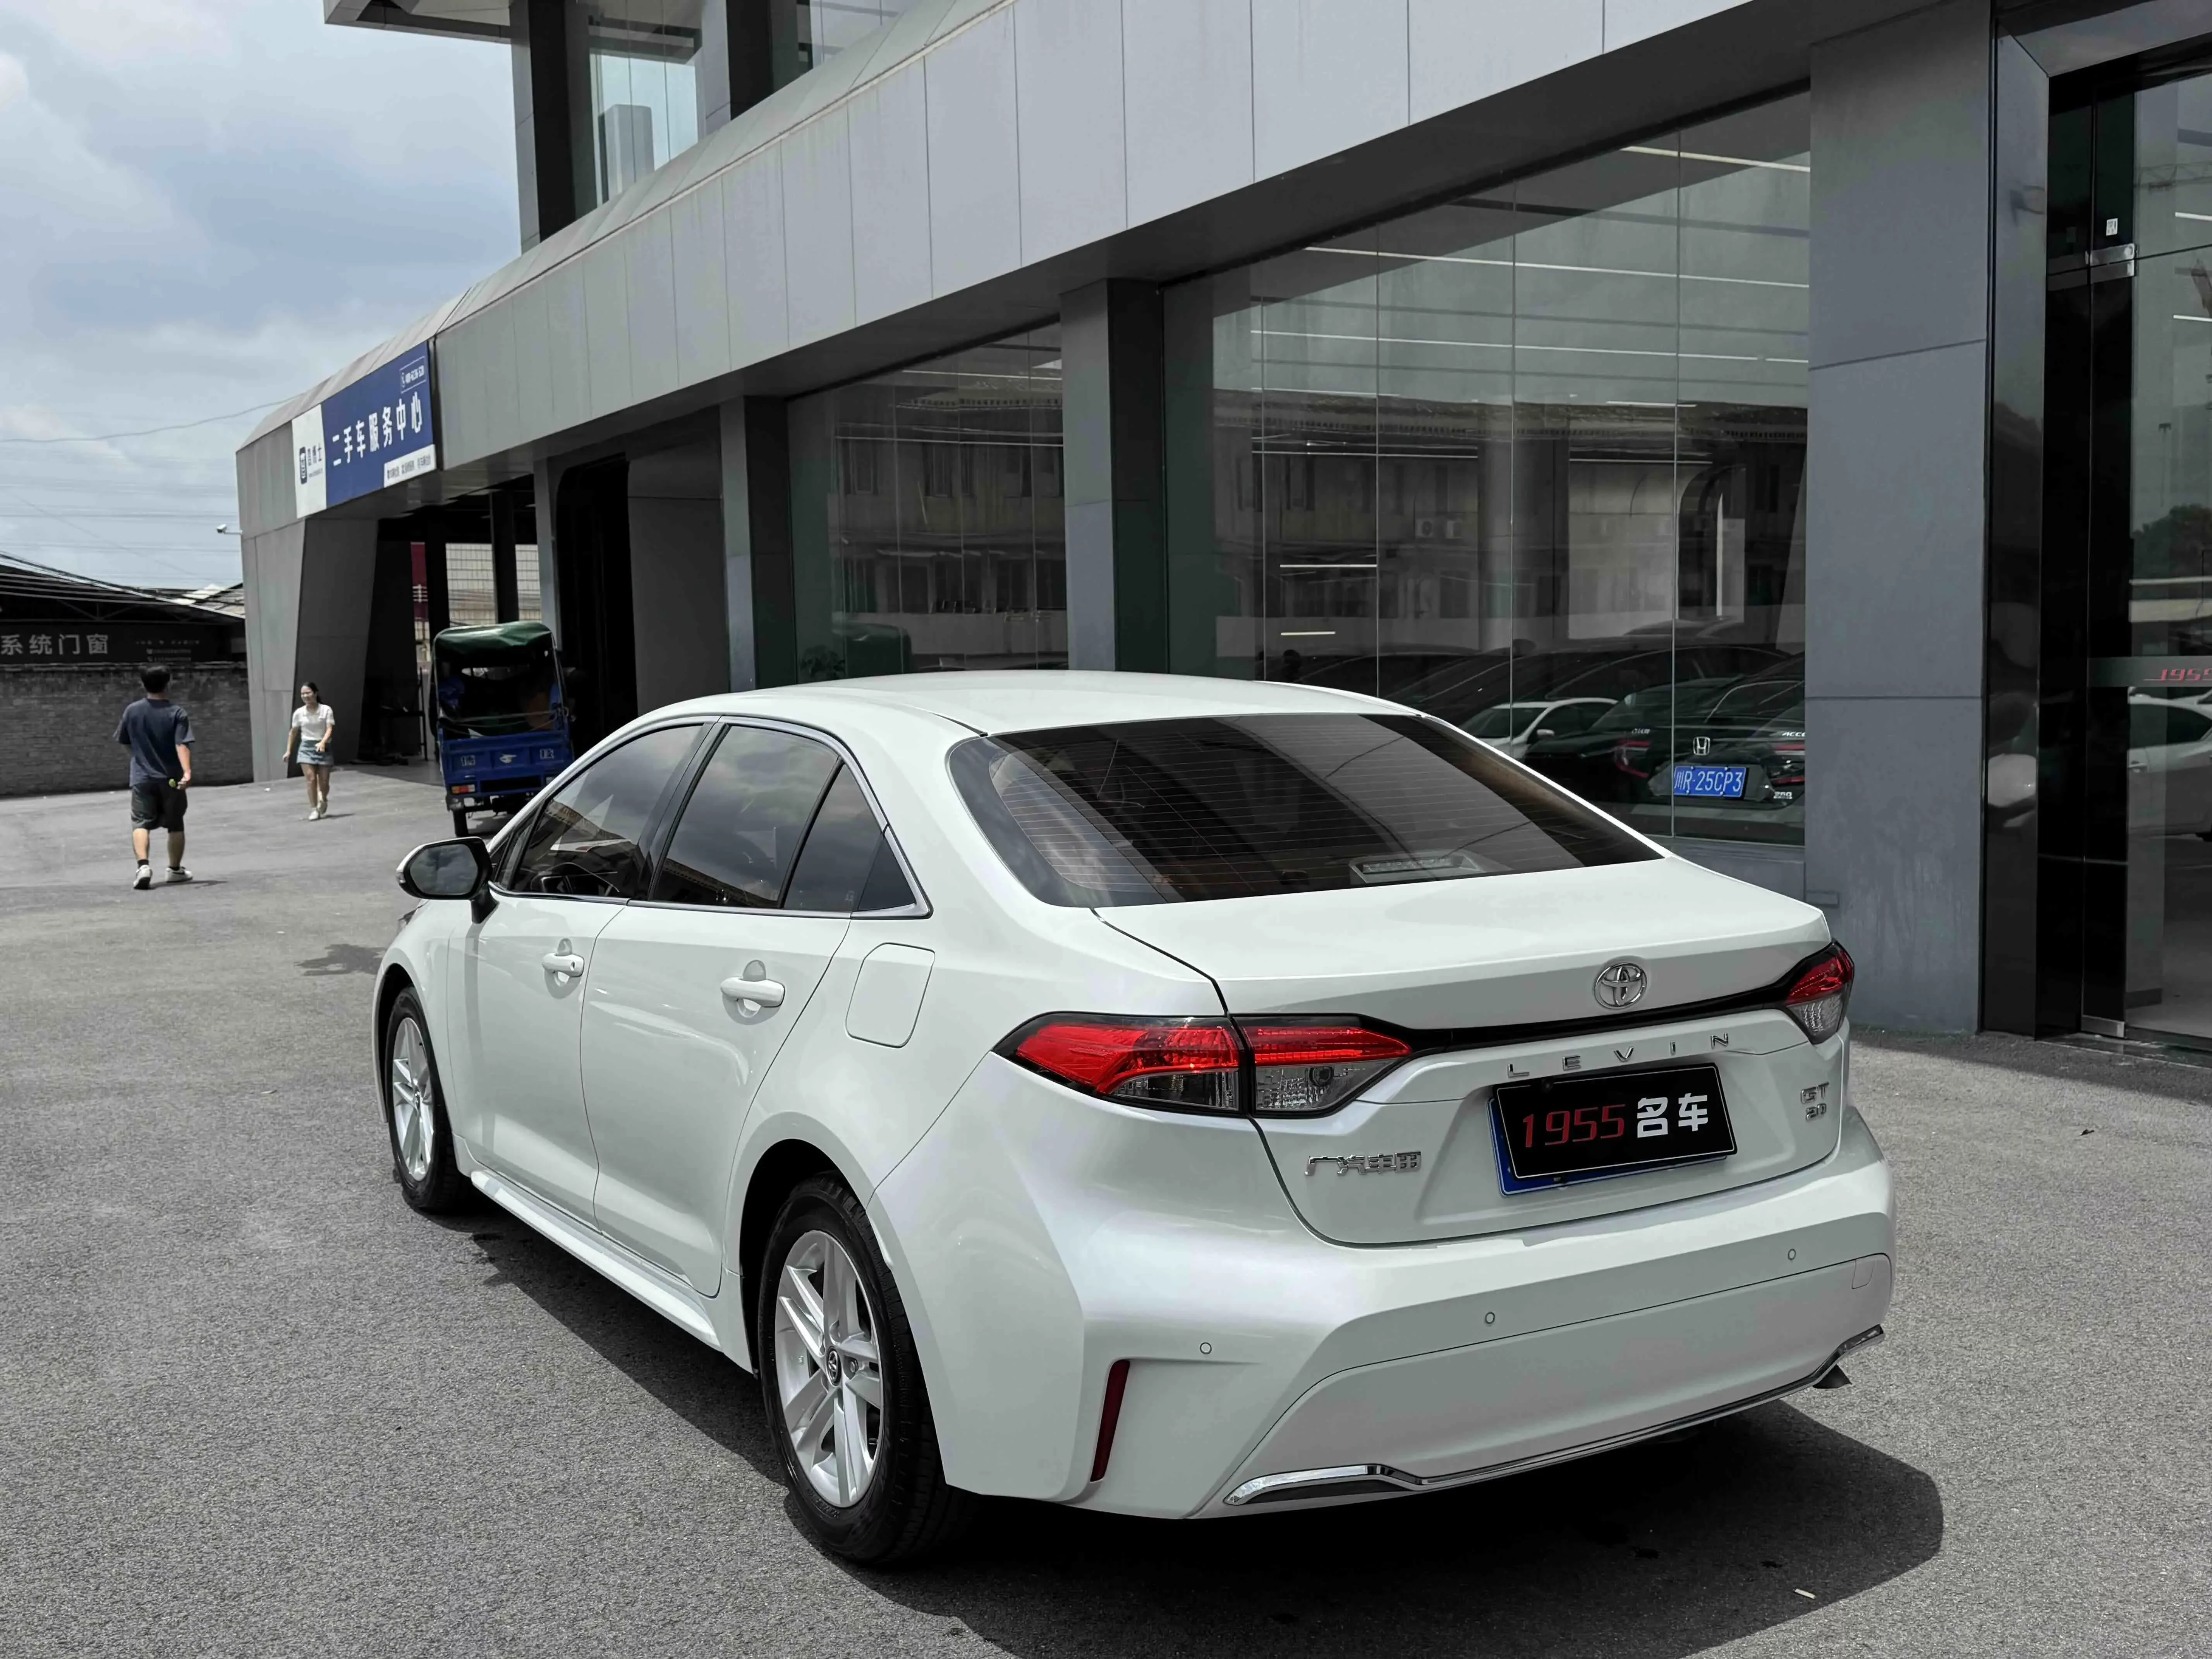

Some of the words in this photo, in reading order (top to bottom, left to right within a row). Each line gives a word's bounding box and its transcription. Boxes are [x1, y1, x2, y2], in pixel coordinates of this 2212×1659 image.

[332, 391, 422, 466] 二手车服务中心
[1, 634, 109, 656] 系统门窗
[1507, 1032, 1729, 1078] LEVIN
[1800, 1081, 1830, 1104] GT
